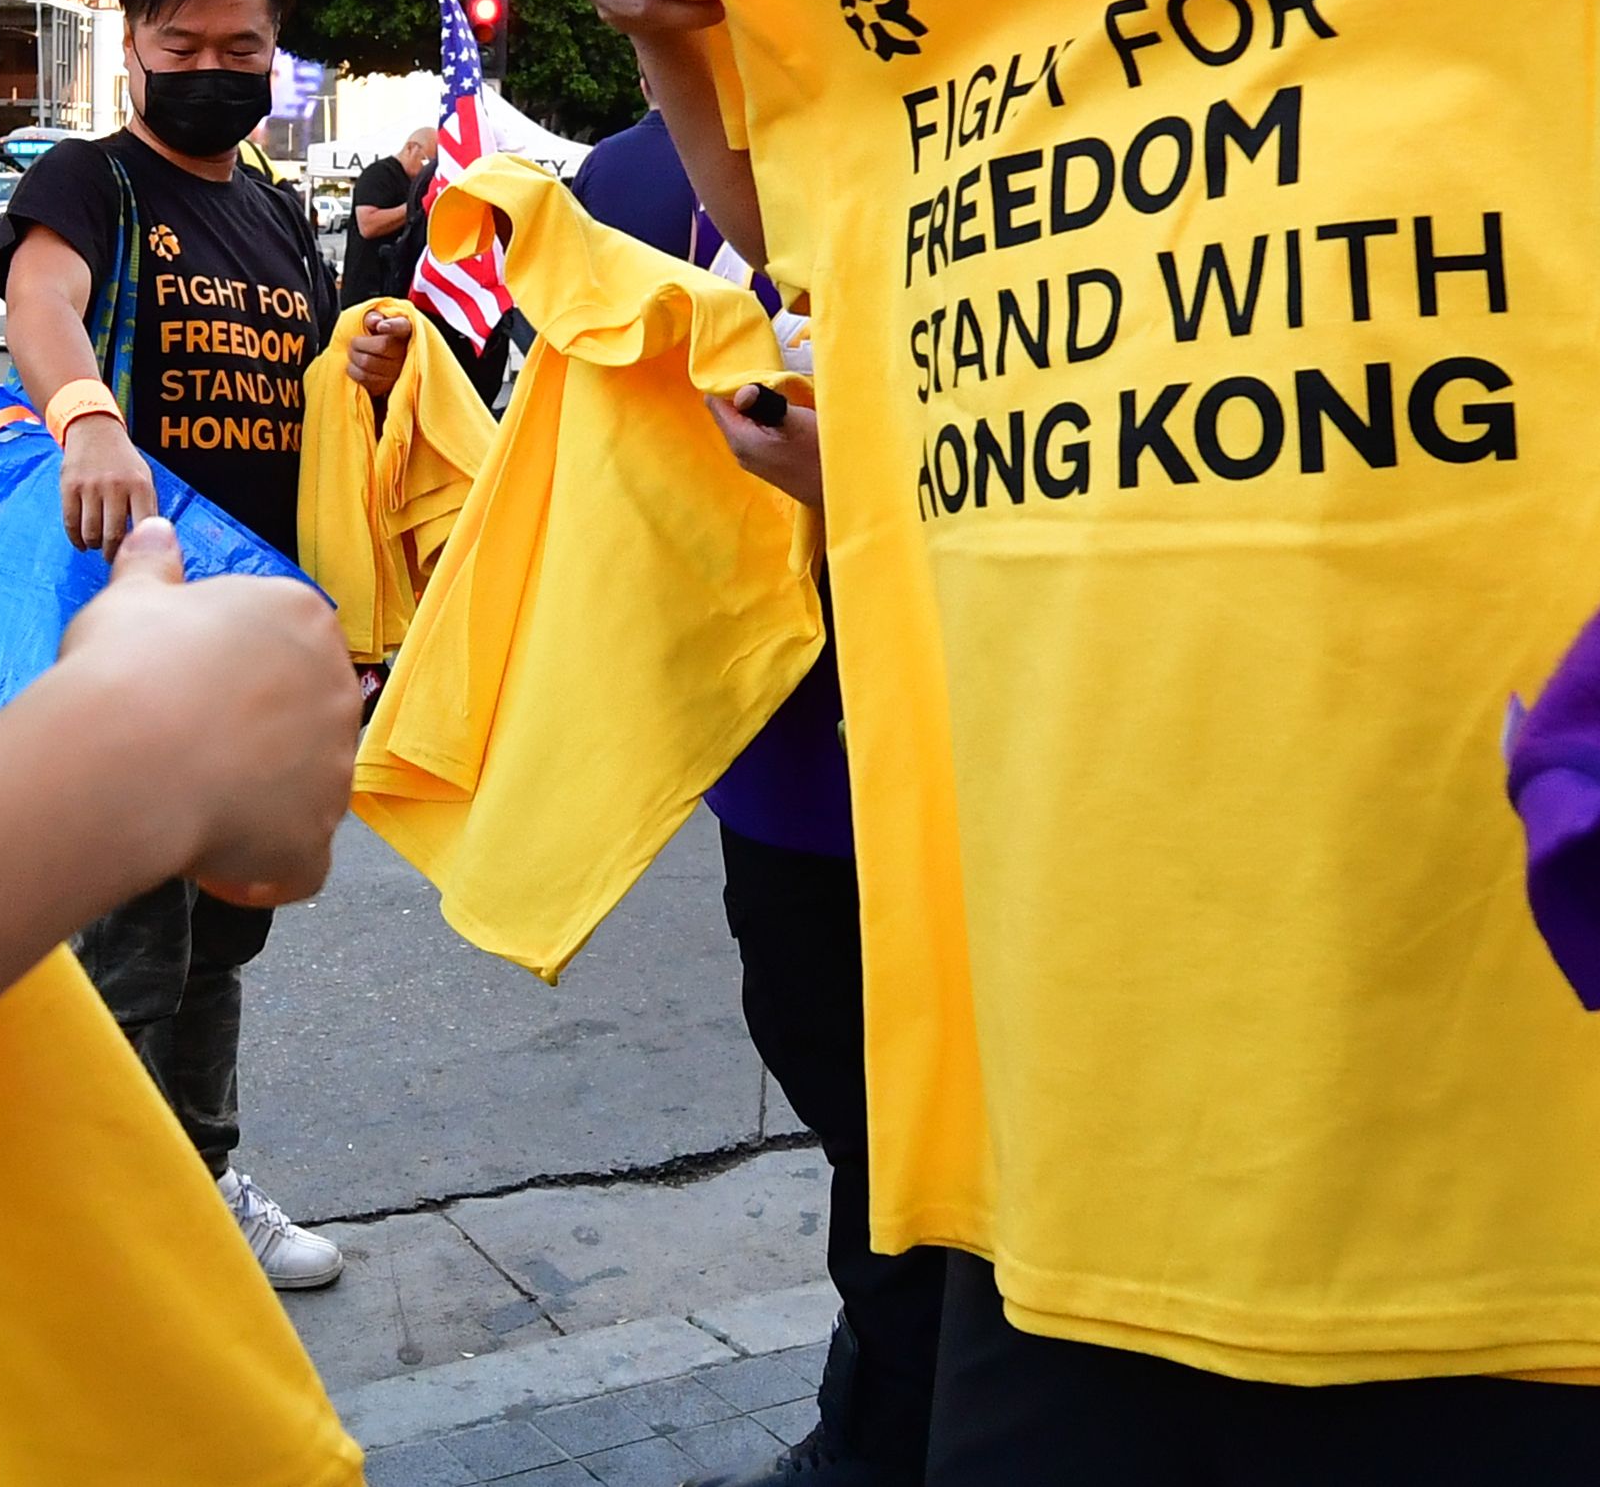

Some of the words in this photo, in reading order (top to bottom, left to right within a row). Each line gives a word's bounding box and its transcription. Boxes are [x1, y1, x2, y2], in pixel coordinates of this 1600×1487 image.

[332, 152, 365, 170] LA
[904, 85, 1303, 290] FREEDOM
[155, 274, 247, 312] FIGHT
[256, 284, 312, 323] FOR
[910, 268, 1123, 404] STAND
[1157, 211, 1509, 344] WITH
[160, 320, 306, 366] FREEDOM
[160, 369, 276, 405] STAND
[160, 416, 276, 451] HONG
[917, 400, 1091, 523] HONG
[1118, 355, 1518, 489] KONG
